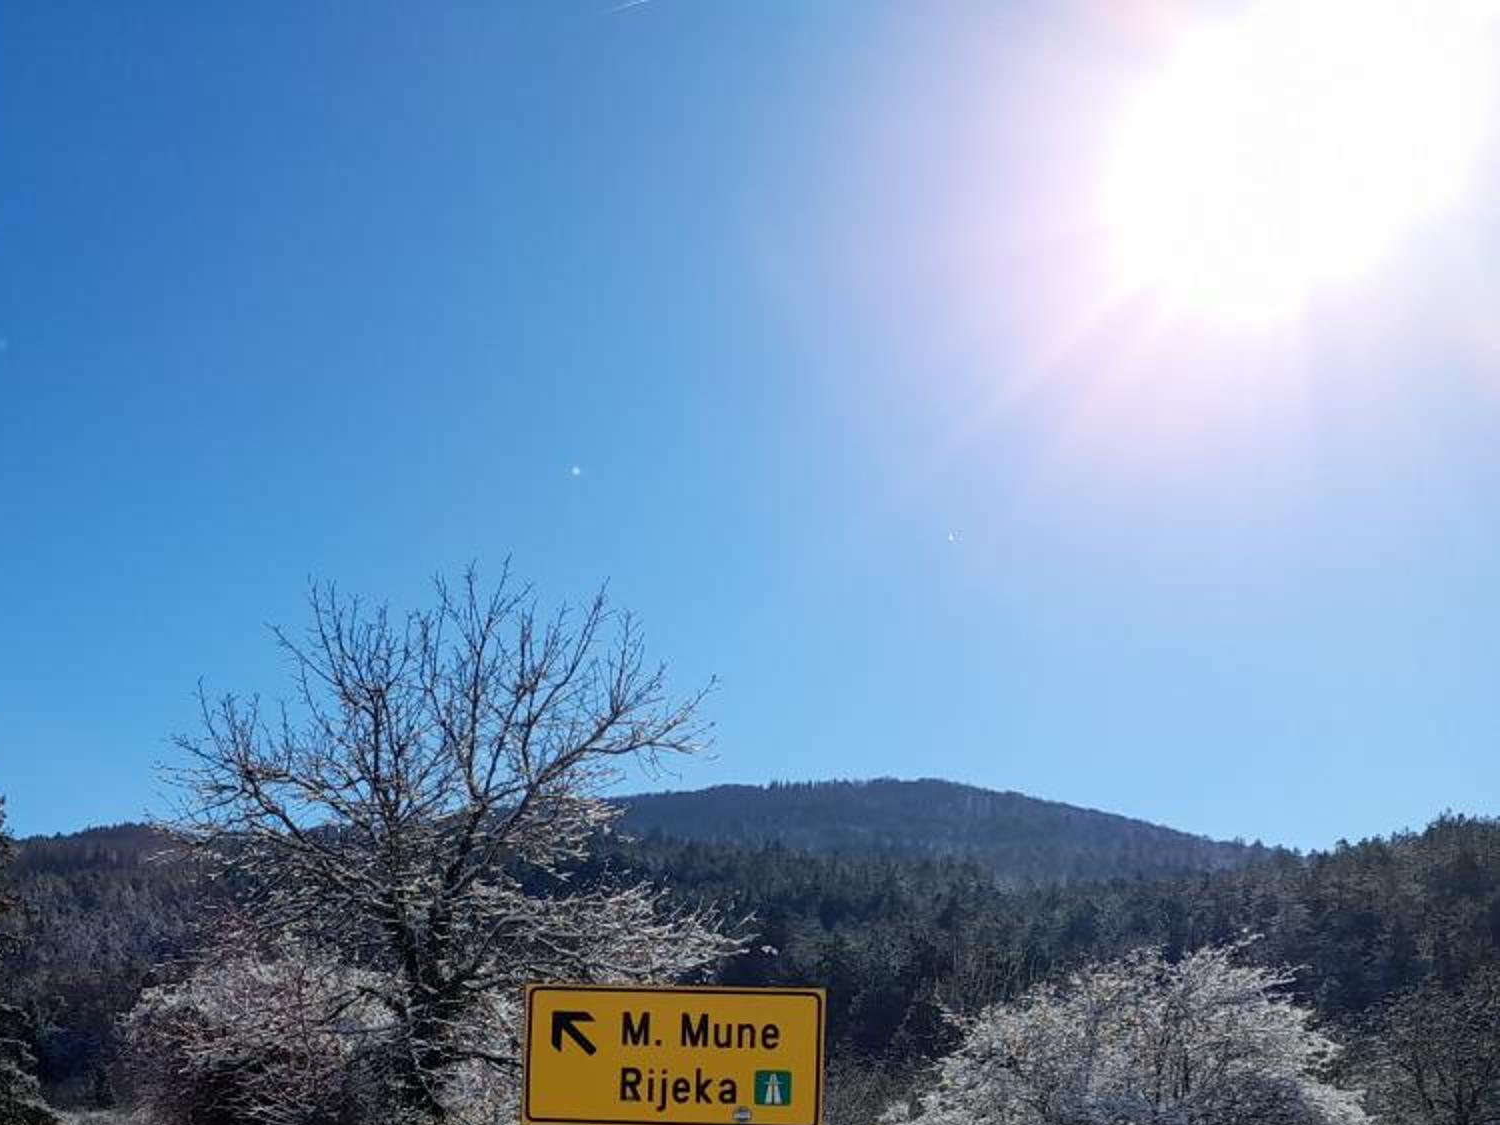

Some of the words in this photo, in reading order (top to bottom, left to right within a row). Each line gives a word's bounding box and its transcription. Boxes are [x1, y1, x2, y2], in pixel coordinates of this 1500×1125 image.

[621, 1012, 662, 1047] M.
[680, 1012, 780, 1049] Mune
[619, 1067, 738, 1112] Rijeka
